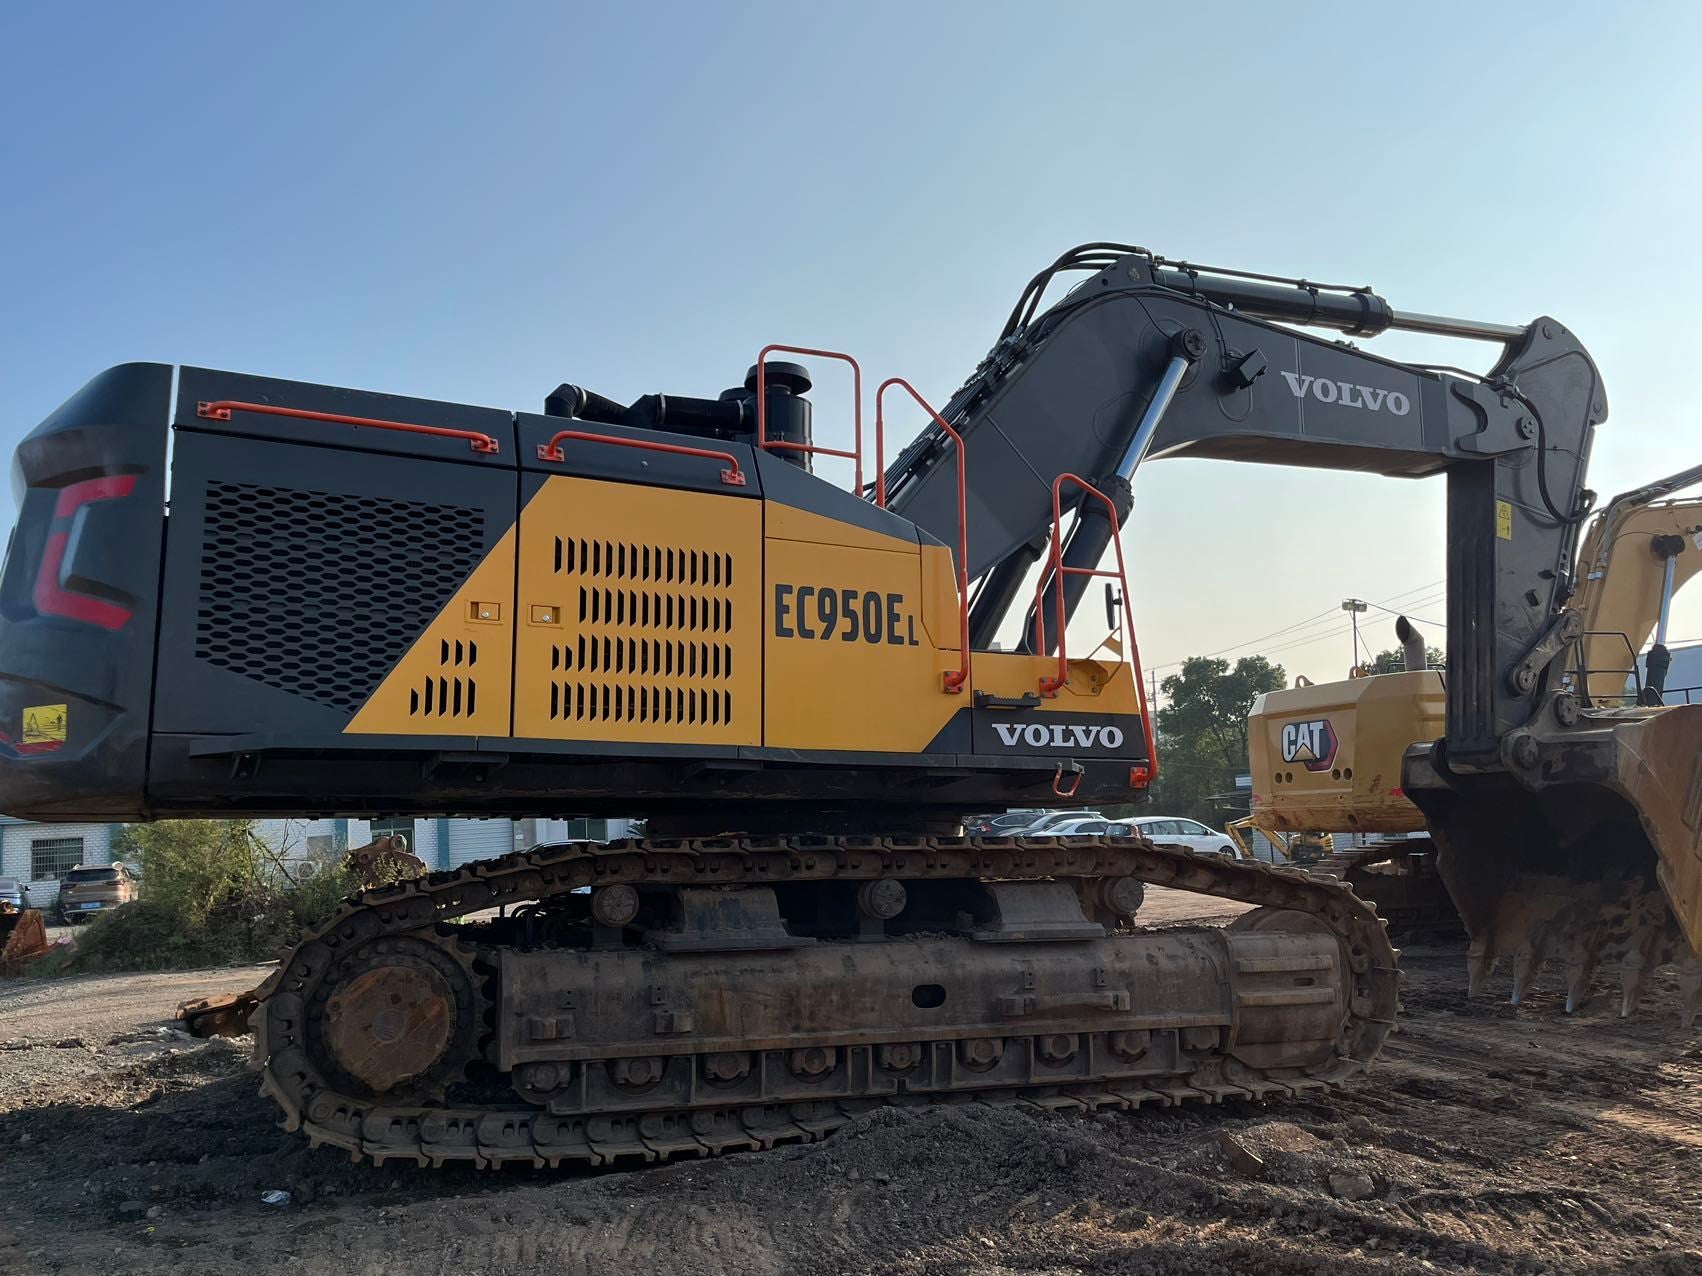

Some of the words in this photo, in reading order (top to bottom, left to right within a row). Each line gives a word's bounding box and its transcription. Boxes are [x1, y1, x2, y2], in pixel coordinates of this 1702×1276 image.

[1280, 370, 1410, 415] VOLVO
[991, 723, 1124, 748] VOLVO
[1282, 721, 1324, 761] CAT
